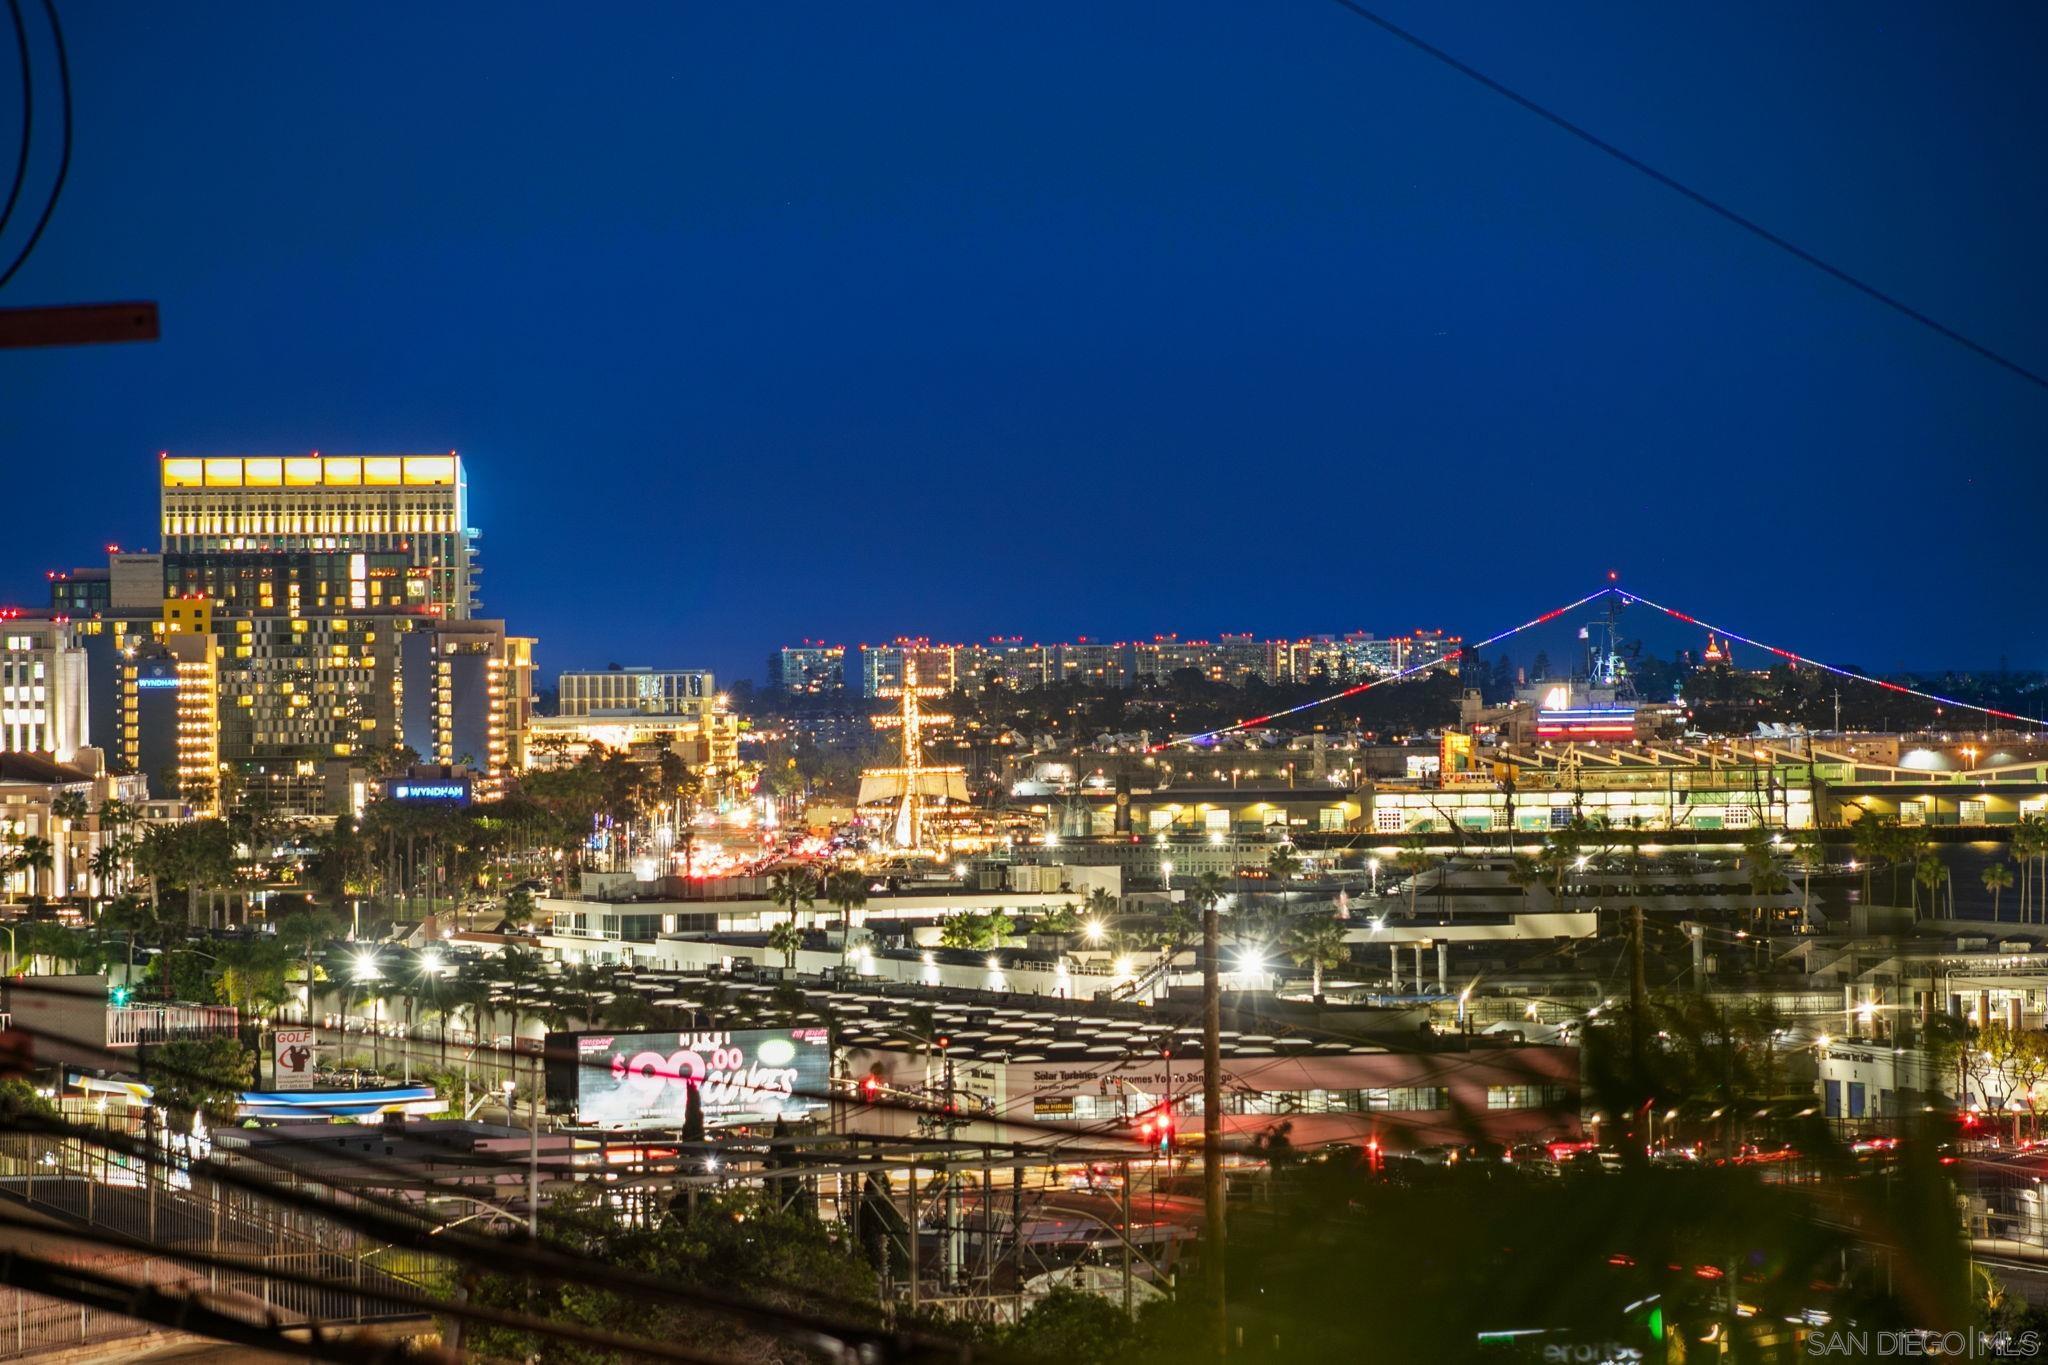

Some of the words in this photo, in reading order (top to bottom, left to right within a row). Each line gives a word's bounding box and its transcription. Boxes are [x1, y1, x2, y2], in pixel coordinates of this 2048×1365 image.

[1545, 688, 1567, 710] 41
[410, 786, 463, 798] WYNDHAM
[277, 1032, 311, 1043] GOLF
[1034, 1071, 1057, 1081] Solar
[1060, 1070, 1098, 1080] Turbines
[1187, 1072, 1204, 1082] San
